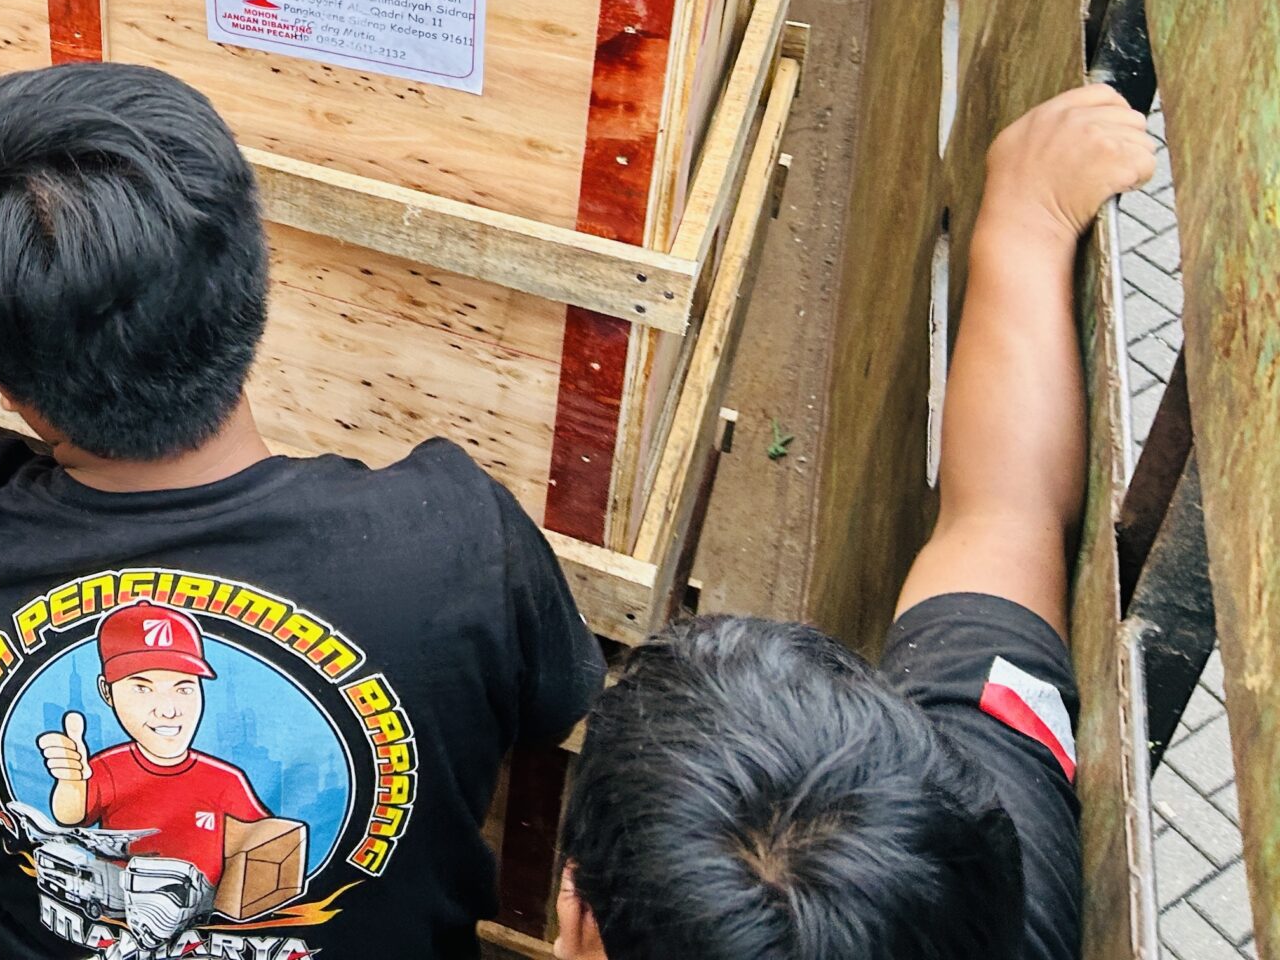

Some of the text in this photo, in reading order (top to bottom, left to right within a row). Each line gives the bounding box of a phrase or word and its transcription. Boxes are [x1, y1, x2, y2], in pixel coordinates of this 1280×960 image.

[222, 12, 313, 34] JANGAN DIBANTING
[244, 8, 278, 20] MOHON
[432, 17, 443, 28] 11
[436, 5, 476, 22] Sidrap
[231, 22, 264, 34] MUDAH
[348, 16, 386, 32] Sidrap
[390, 23, 438, 40] Kodepos
[441, 32, 474, 47] 91611
[12, 567, 366, 683] PENGIRIMAN
[339, 673, 418, 876] BARANG
[39, 893, 323, 960] MAARYA
